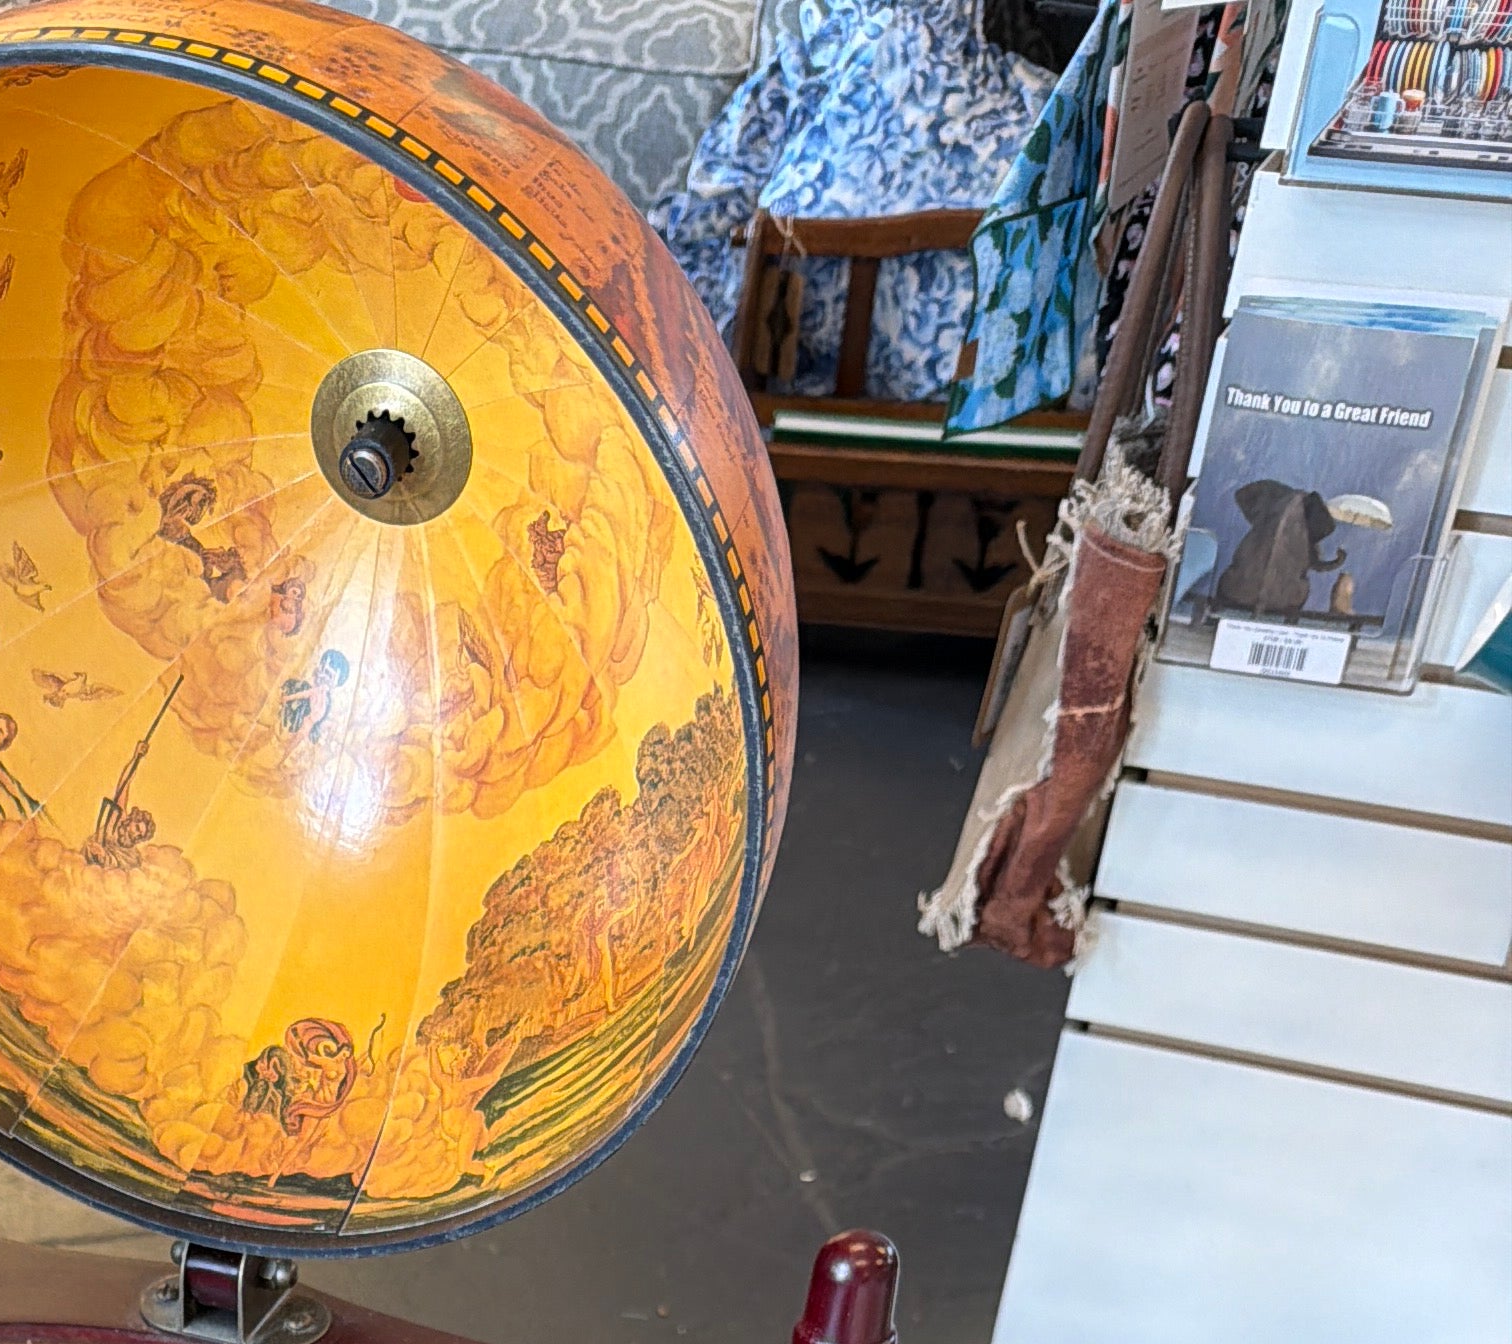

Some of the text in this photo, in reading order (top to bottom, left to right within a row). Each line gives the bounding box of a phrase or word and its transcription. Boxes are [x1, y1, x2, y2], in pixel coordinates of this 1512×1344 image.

[1226, 386, 1432, 428] Thank You to a Great Friend
